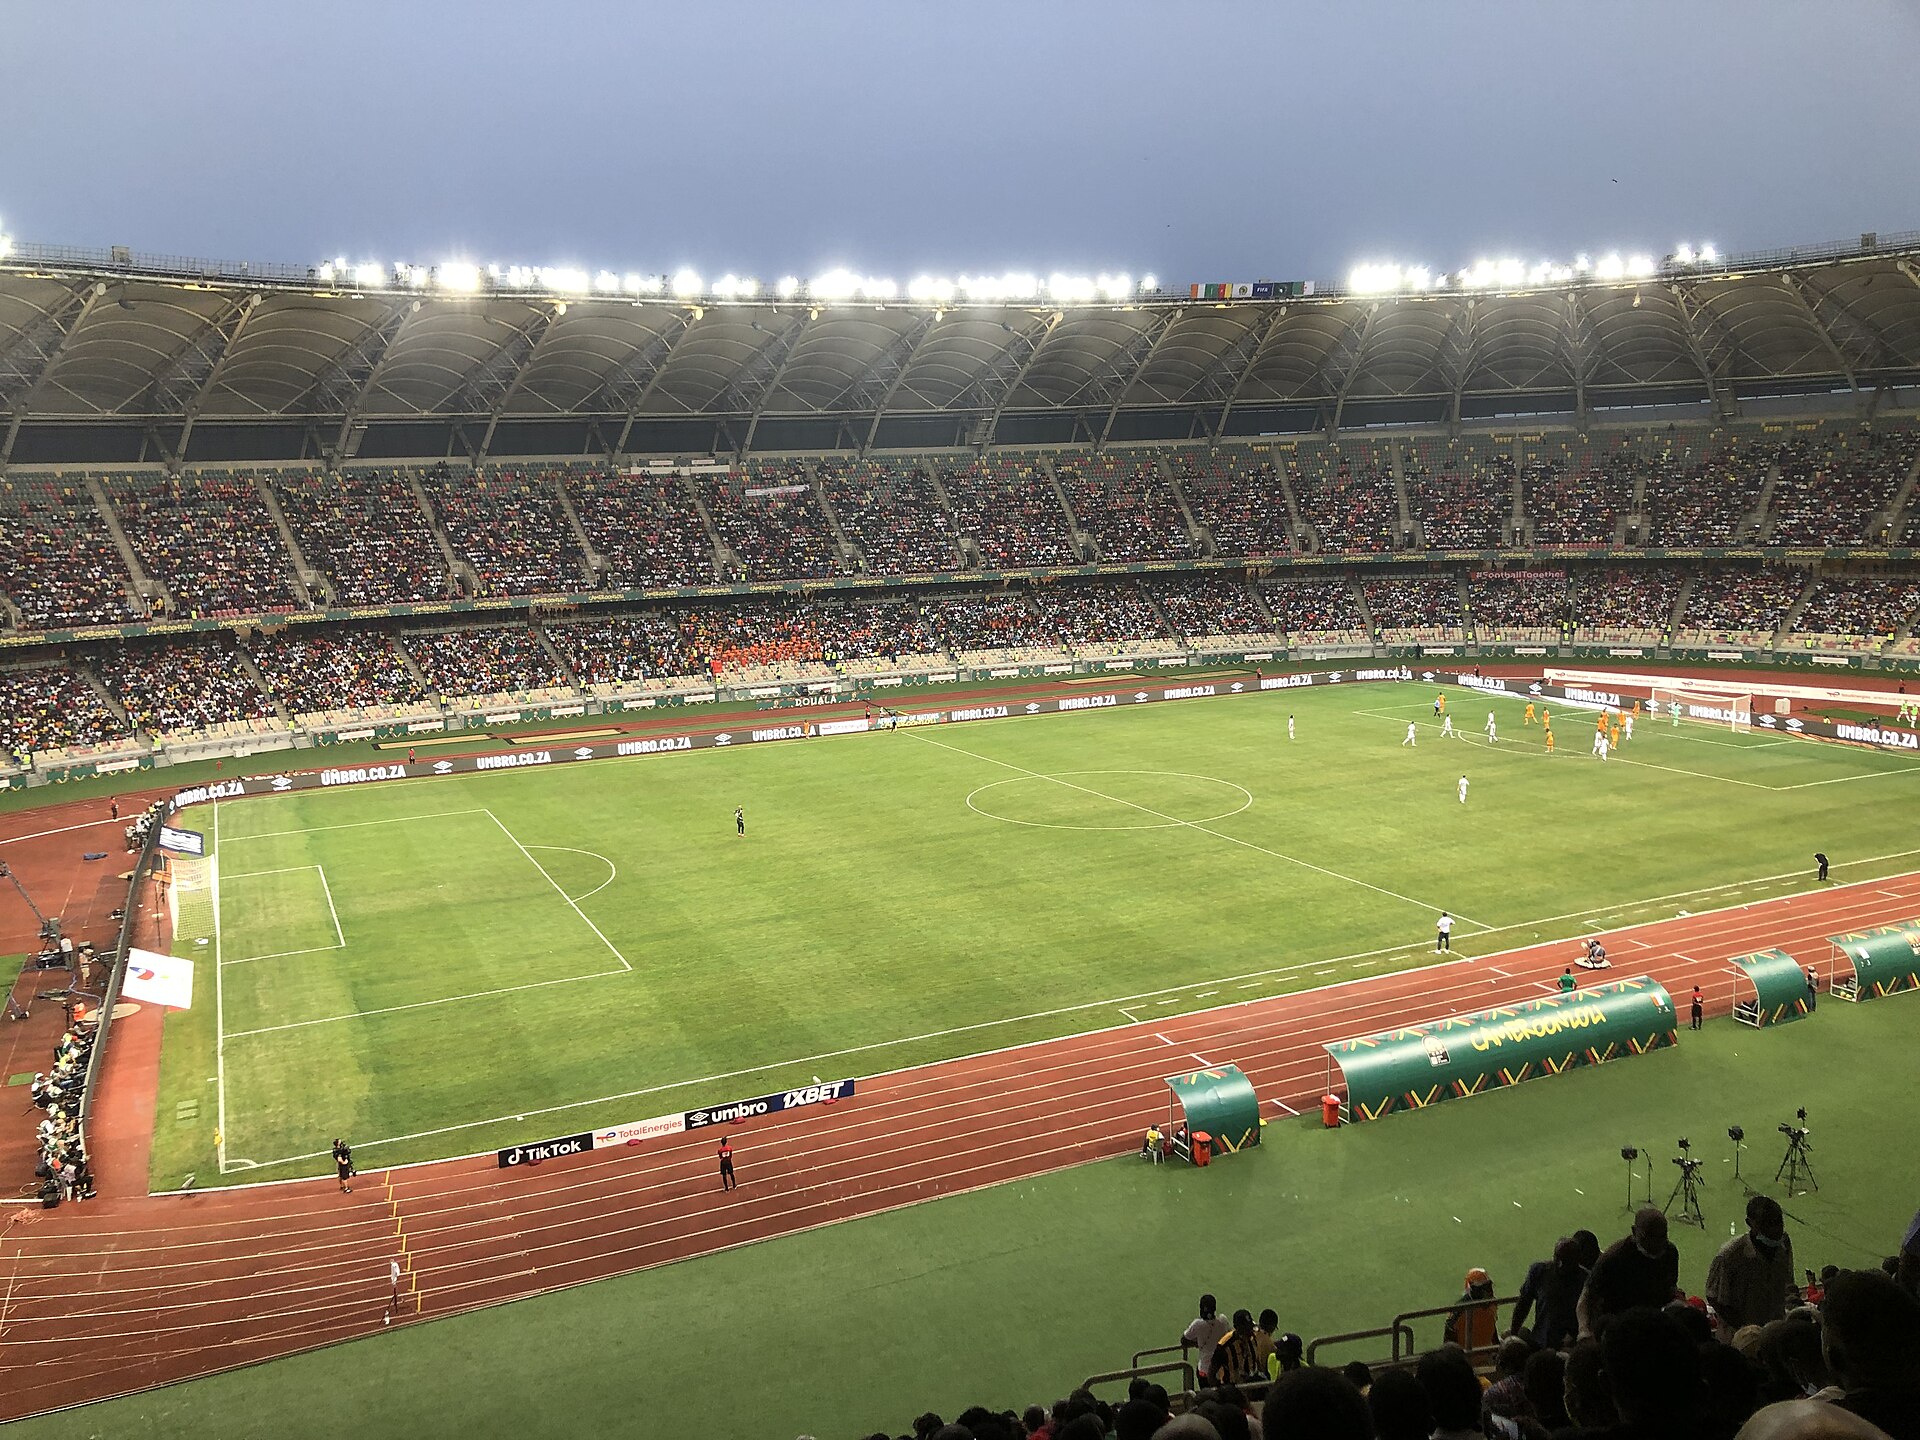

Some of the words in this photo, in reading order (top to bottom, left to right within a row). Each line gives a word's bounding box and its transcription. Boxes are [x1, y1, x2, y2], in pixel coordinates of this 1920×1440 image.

[1260, 674, 1312, 689] UMBRO.CO.ZA
[1458, 674, 1505, 690] UMBRO.CO.ZA
[795, 695, 837, 706] DOUALA
[1164, 685, 1215, 700] UMBRO.CO.ZA
[1564, 687, 1620, 706] UMBRO.CO.ZA
[1059, 695, 1116, 710] UMBRO.CO.ZA
[951, 706, 1008, 721] UMBRO.CO.ZA
[752, 725, 816, 741] UMBRO.CO.A
[1837, 724, 1918, 749] UMBRO.CO.ZA
[618, 737, 691, 755] UMBRO.CO.ZA
[476, 751, 552, 769] UMBRO.CO.ZA
[320, 764, 406, 785] UMBRO.CO.ZA
[175, 782, 245, 807] UMBRO.CO.ZA
[1470, 1004, 1606, 1051] CAMEROON2021
[783, 1082, 844, 1109] 1XBET
[712, 1102, 768, 1122] umbro
[618, 1120, 682, 1138] TotalEnergies
[526, 1140, 581, 1160] TikTok
